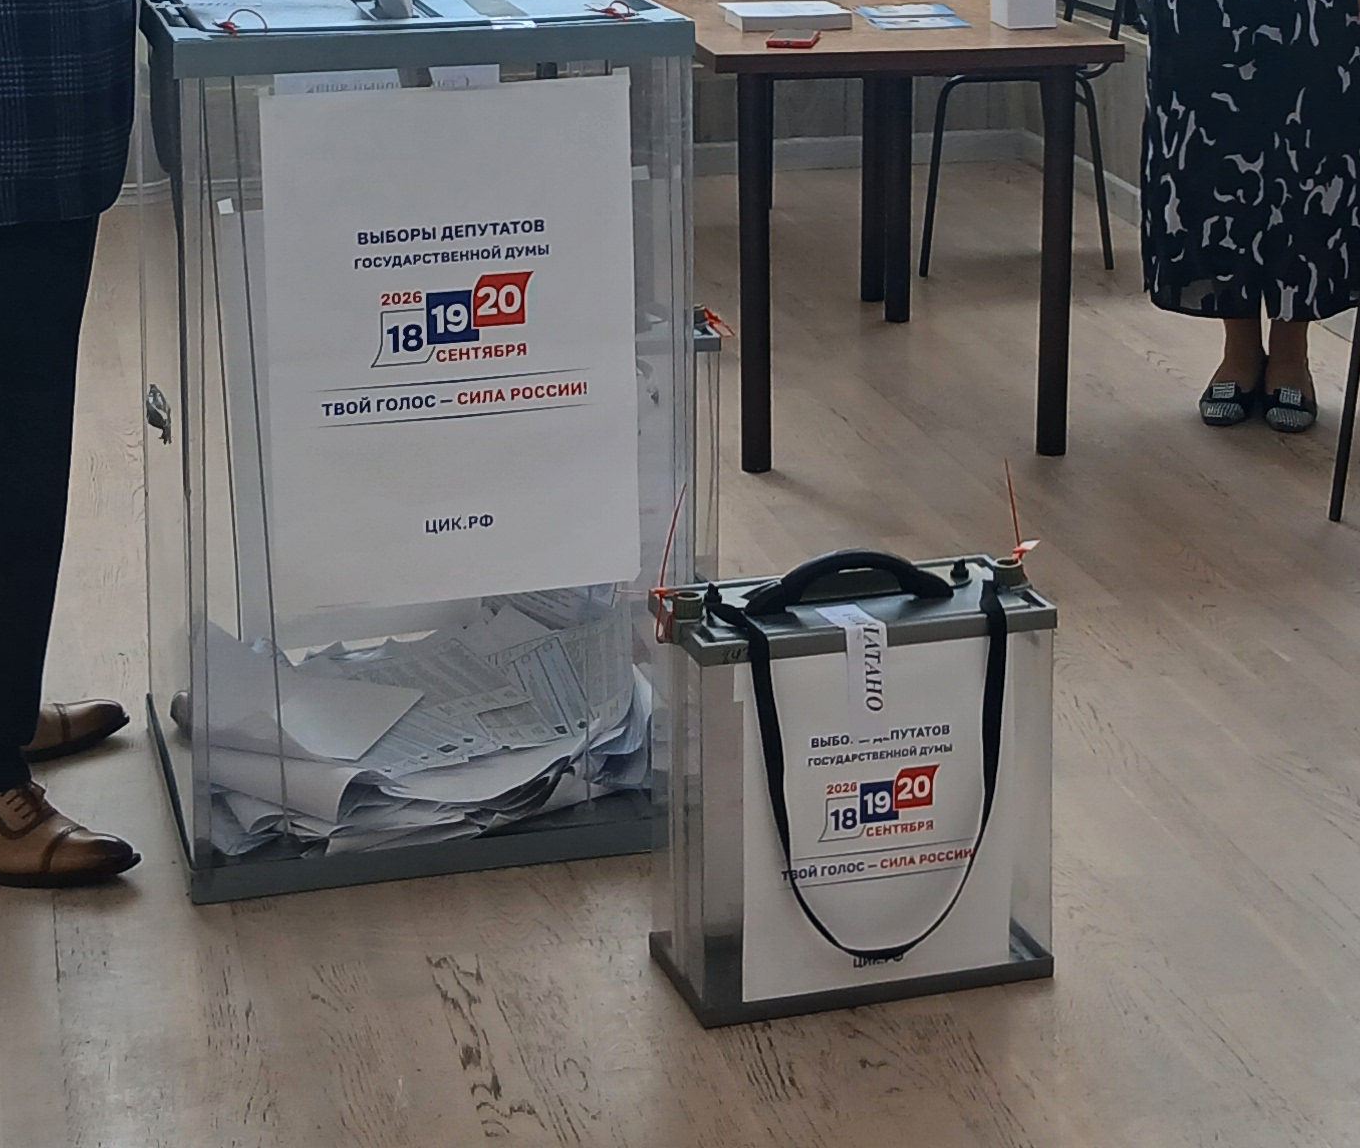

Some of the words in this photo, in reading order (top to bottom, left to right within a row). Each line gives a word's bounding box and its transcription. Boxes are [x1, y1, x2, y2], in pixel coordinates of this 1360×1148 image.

[357, 226, 437, 246] ВЫБОРЫ
[440, 219, 546, 242] ДЕПУТАТОВ
[354, 246, 502, 270] ГОСУДАРСТВЕННОЙ
[504, 244, 550, 261] ДУМЫ
[380, 291, 423, 306] 2026
[386, 324, 424, 353] 18
[430, 303, 469, 334] 19
[476, 284, 521, 317] 20
[435, 342, 527, 363] СЕНТЯБРЯ
[321, 397, 371, 417] ТВОЙ
[376, 395, 436, 413] ГОЛОС
[457, 387, 506, 405] СИЛА
[510, 382, 588, 401] РОССИИ!
[425, 514, 494, 534] ЦИК.РФ
[811, 735, 870, 748] ВЫБО
[873, 724, 951, 744] ПУТАТОВ
[807, 746, 917, 767] ГОСУДАРСТВЕННОЙ
[918, 743, 953, 756] ДУМЫ
[826, 782, 857, 795] 2026
[830, 808, 857, 831] 18
[863, 791, 890, 815] 19
[897, 775, 931, 801] 20
[866, 820, 934, 838] СЕНТЯБРЯ
[821, 861, 865, 877] ГОЛОС
[880, 854, 916, 870] СИЛА
